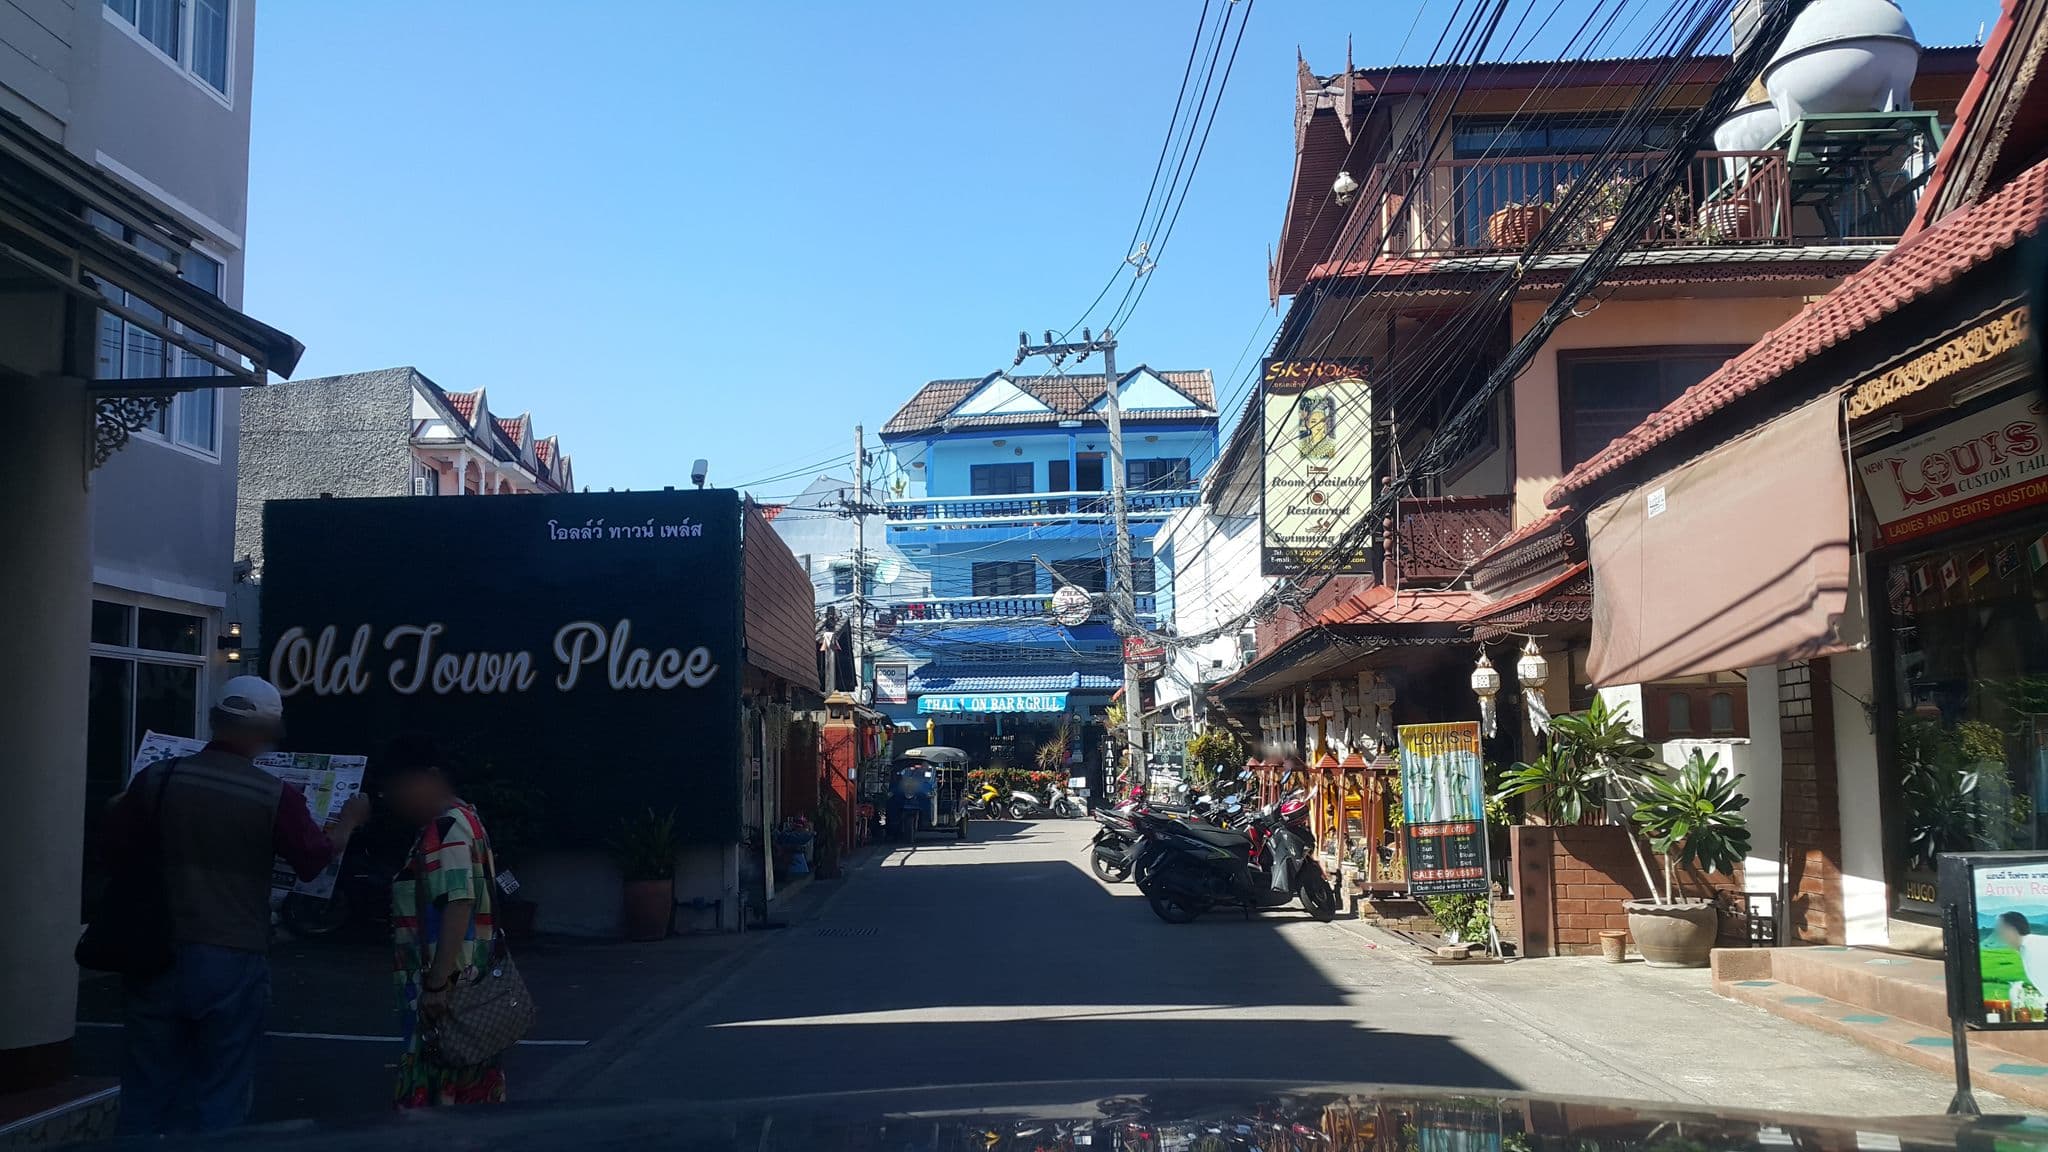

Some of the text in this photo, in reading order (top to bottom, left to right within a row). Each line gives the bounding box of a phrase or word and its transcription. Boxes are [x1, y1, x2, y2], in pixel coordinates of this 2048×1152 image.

[1864, 459, 1885, 476] NEW
[1271, 476, 1365, 488] Room Available
[1958, 465, 2011, 493] CUSTOM
[1286, 504, 1351, 516] Restaurant
[1888, 516, 1925, 538] LADIES
[1927, 508, 1950, 527] AND
[1951, 497, 1991, 519] GENTS
[609, 518, 655, 539] ทาวน์
[1273, 532, 1335, 545] Swimming
[270, 618, 719, 698] Old Town Place
[924, 699, 955, 711] THAI
[971, 697, 987, 711] ON
[1105, 740, 1115, 794] TATTOO
[1418, 826, 1447, 835] Special
[1413, 870, 1434, 879] SALE
[1906, 880, 1936, 903] HUGO
[1985, 882, 2025, 897] Anny
